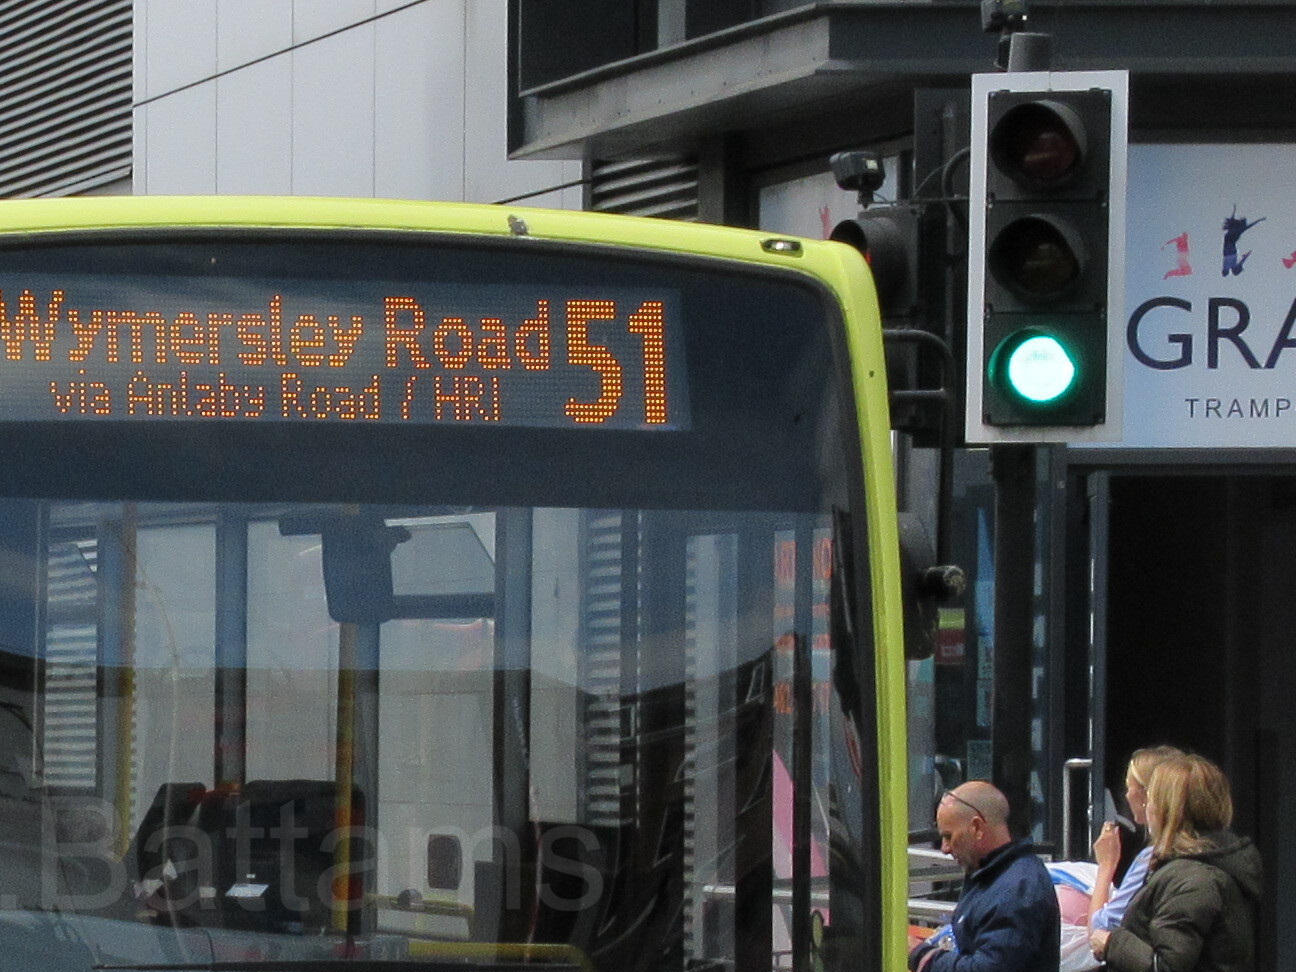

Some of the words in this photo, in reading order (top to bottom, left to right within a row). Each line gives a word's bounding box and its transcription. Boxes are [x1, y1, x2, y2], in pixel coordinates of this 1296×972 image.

[384, 296, 550, 370] Road
[563, 300, 668, 424] 51
[49, 369, 111, 415] via
[280, 372, 380, 420] Road
[433, 375, 501, 421] HRI
